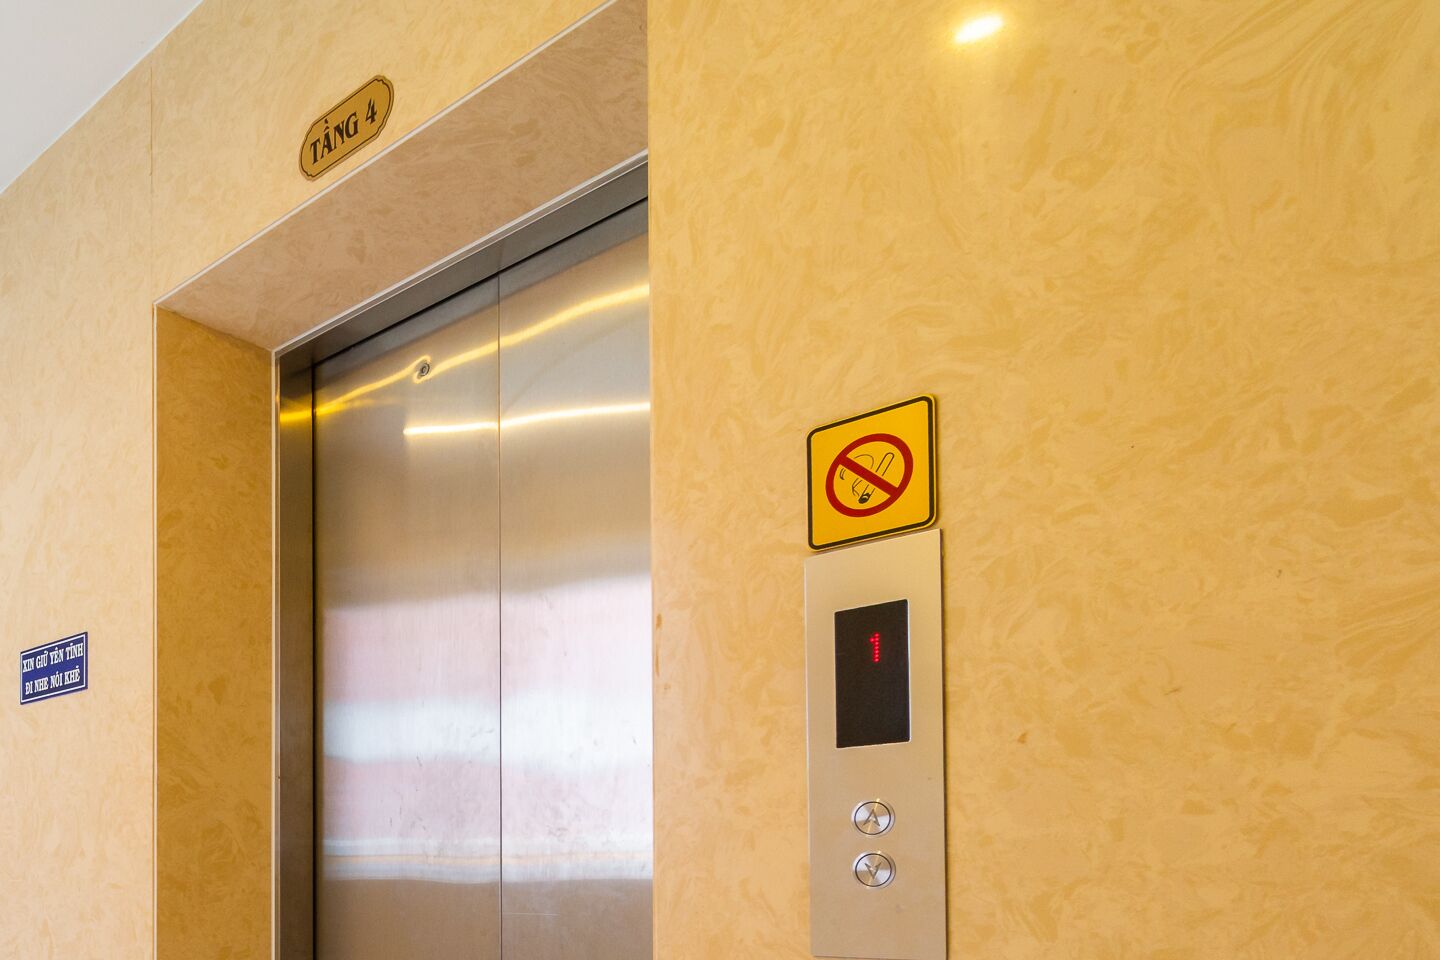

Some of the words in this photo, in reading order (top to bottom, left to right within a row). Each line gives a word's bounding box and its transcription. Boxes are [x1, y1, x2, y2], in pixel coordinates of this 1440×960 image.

[310, 118, 359, 165] TẦNG
[365, 98, 377, 125] 4
[22, 658, 35, 673] XIN
[49, 647, 64, 665] YÊN
[869, 632, 880, 663] 1
[25, 681, 33, 695] ĐI
[50, 671, 63, 688] NÓI
